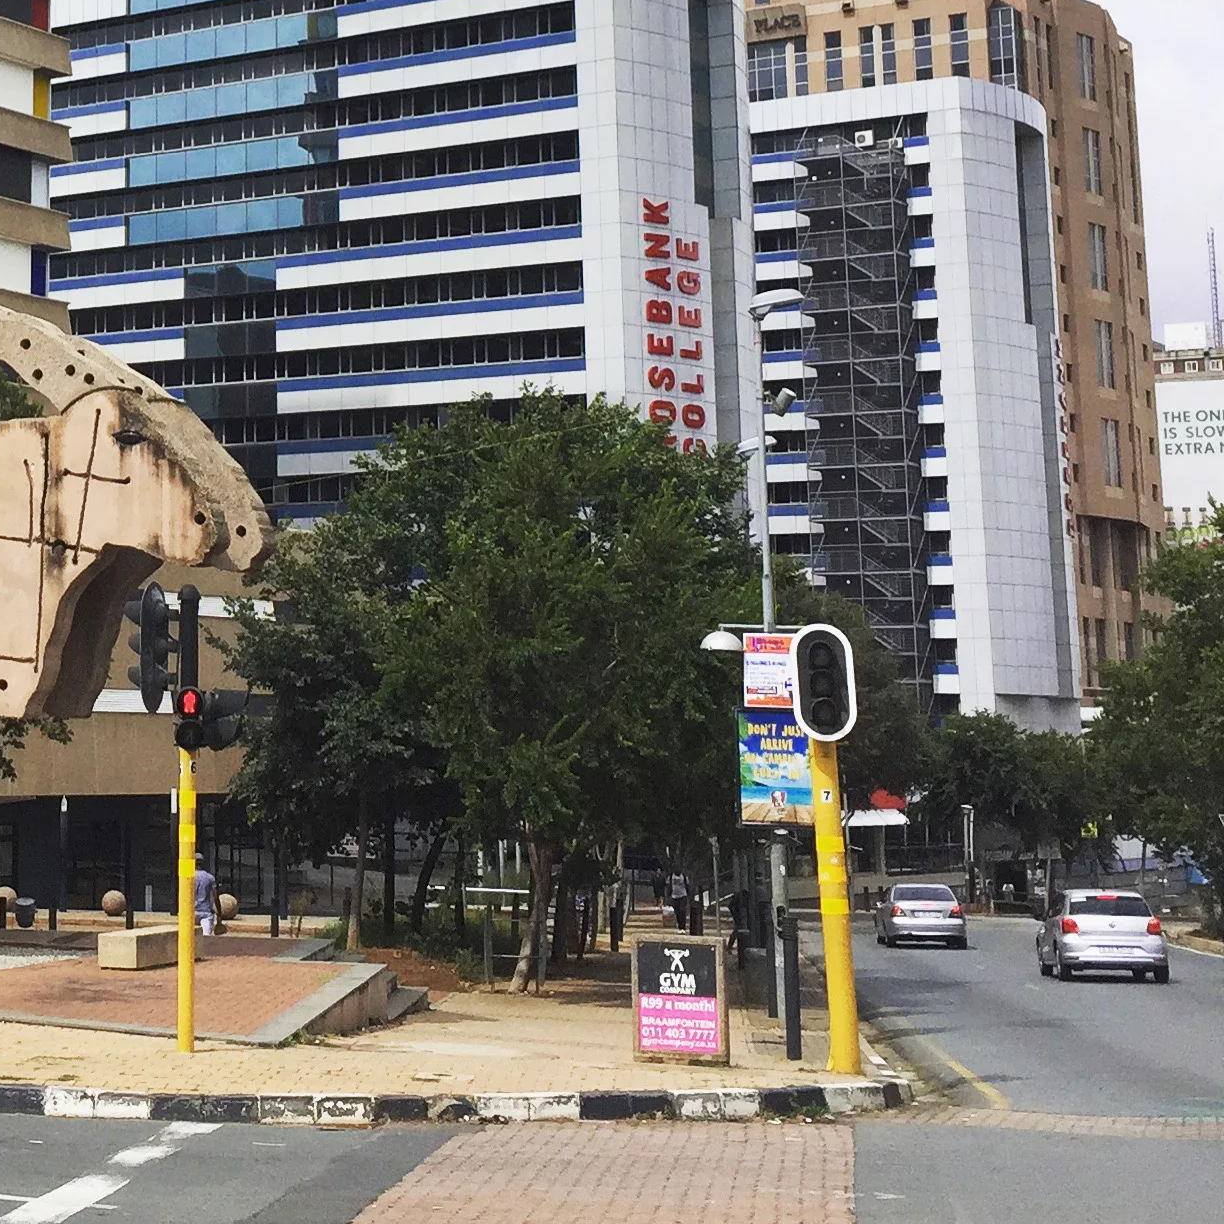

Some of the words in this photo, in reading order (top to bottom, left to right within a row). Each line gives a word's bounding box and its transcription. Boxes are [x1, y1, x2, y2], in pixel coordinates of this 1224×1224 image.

[754, 14, 801, 33] PLACE
[642, 197, 678, 446] OSEBANK
[1163, 411, 1191, 424] THE
[1164, 427, 1177, 439] IS
[1165, 442, 1215, 456] EXTRA
[748, 723, 776, 737] DON'T
[760, 738, 793, 751] ARRIVE
[191, 761, 197, 774] 6
[823, 790, 830, 800] 7
[659, 973, 696, 988] GYM
[659, 986, 696, 995] COMPANY
[641, 997, 663, 1009] R99
[665, 1001, 672, 1010] a
[674, 1000, 714, 1012] month!
[641, 1016, 715, 1029] BRAAMFONTEIN
[642, 1027, 662, 1037] 011
[665, 1028, 686, 1038] 403
[689, 1030, 715, 1040] 7777
